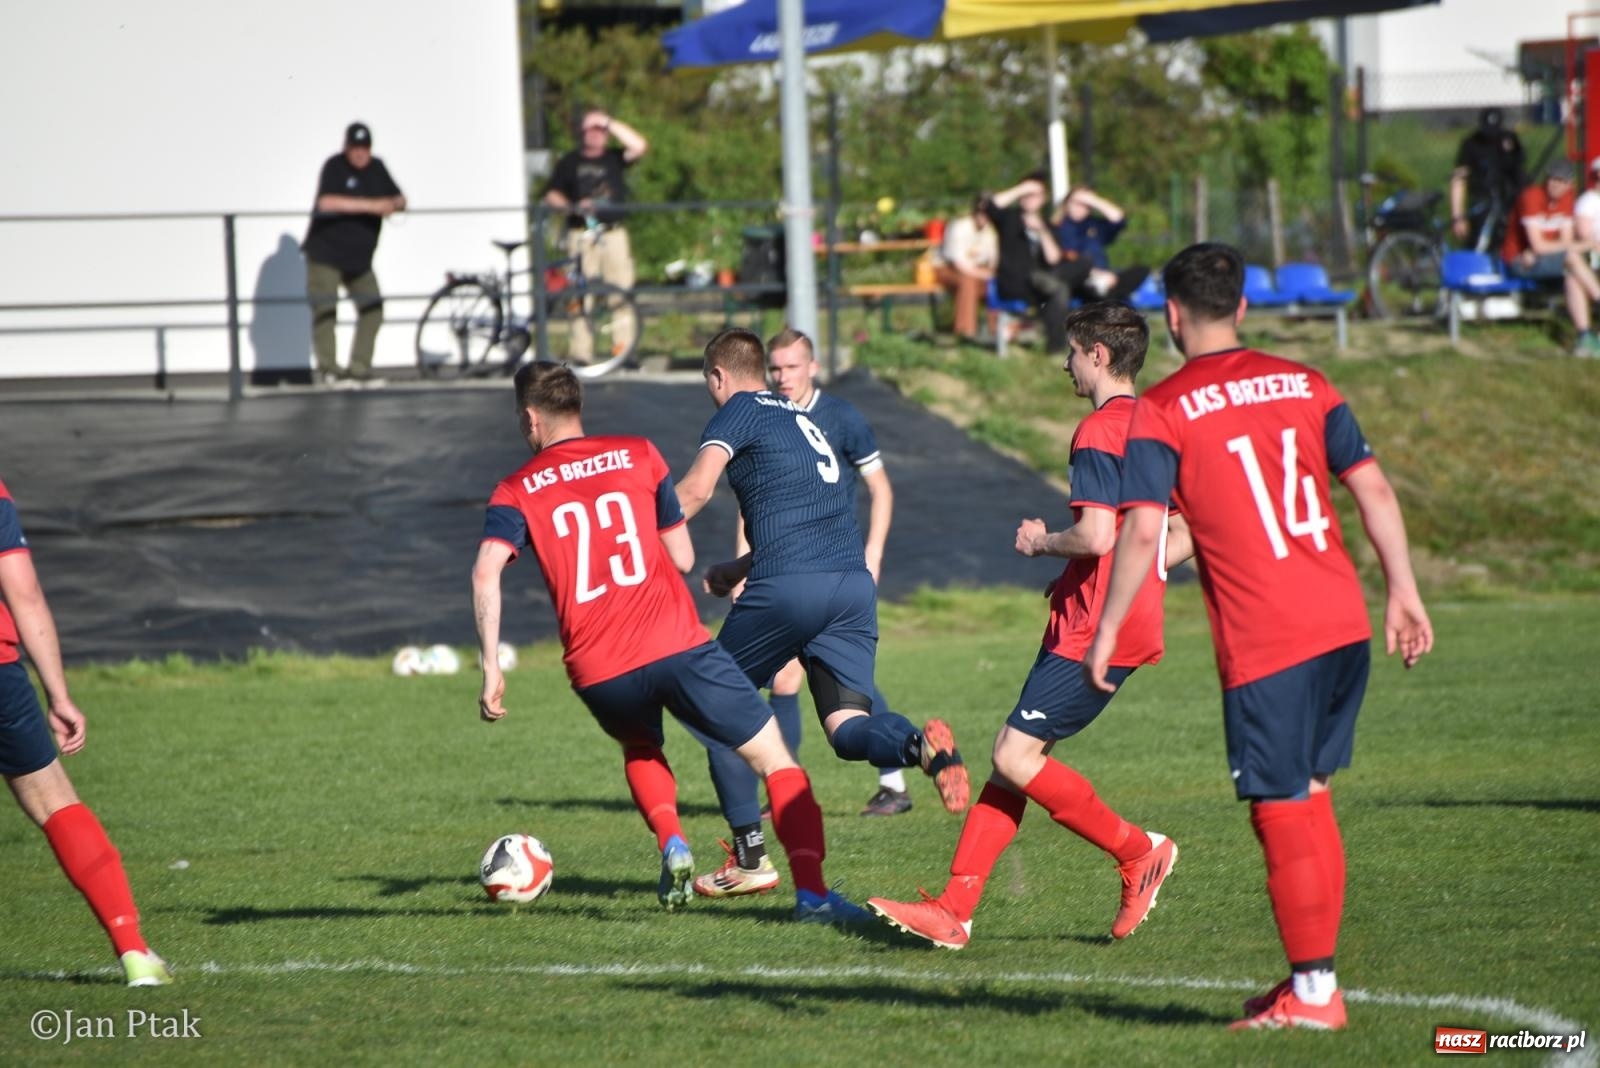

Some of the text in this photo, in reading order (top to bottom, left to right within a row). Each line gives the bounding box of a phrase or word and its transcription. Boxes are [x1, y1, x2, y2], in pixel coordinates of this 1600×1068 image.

[1179, 373, 1313, 421] LKS BRZEZIE
[522, 449, 634, 494] LKS BRZEZIE
[795, 414, 840, 483] 9
[1226, 427, 1330, 560] 14
[552, 491, 648, 604] 23
